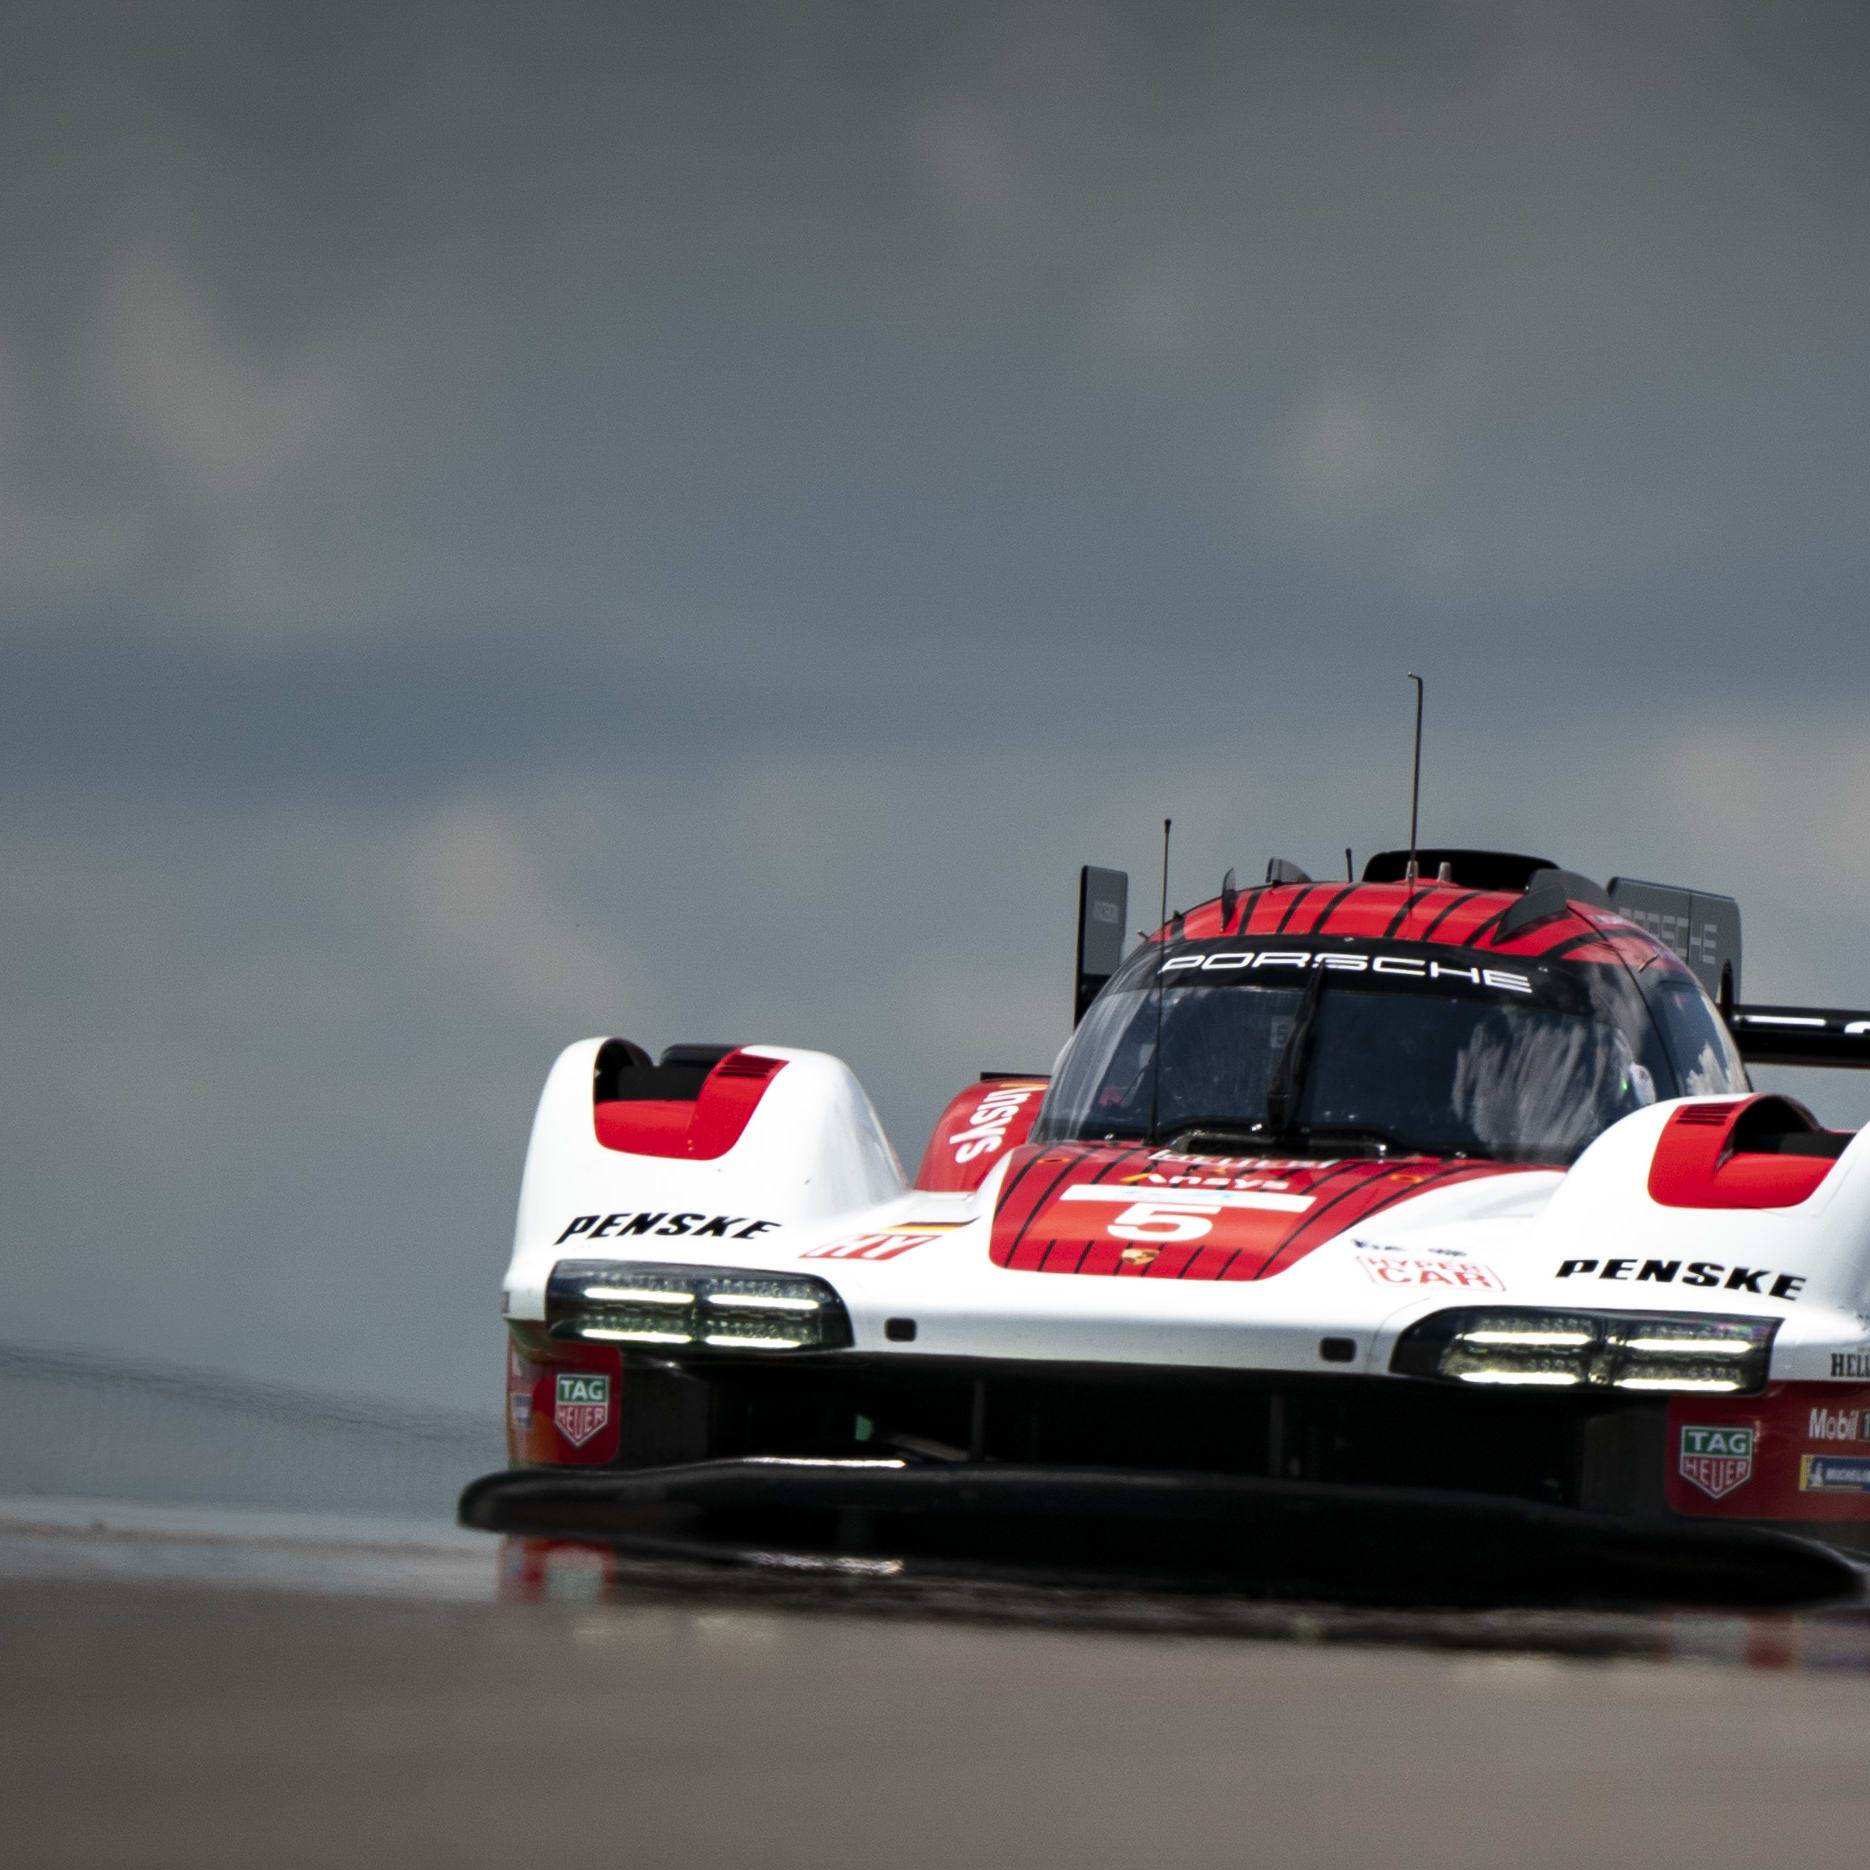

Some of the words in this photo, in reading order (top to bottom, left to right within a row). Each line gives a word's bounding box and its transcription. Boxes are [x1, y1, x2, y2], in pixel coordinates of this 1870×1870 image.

[1158, 951, 1533, 994] PORSCHE
[1120, 1172, 1289, 1190] Ansys
[552, 1211, 783, 1246] PENSKE
[1106, 1202, 1222, 1241] 5
[1377, 1267, 1493, 1288] CAR
[1555, 1258, 1807, 1301] PENSKE
[561, 1380, 604, 1400] TAG
[557, 1407, 604, 1440] HEUER
[1809, 1408, 1860, 1440] Mobil
[1688, 1431, 1747, 1454] TAG
[1684, 1458, 1747, 1492] HEUER
